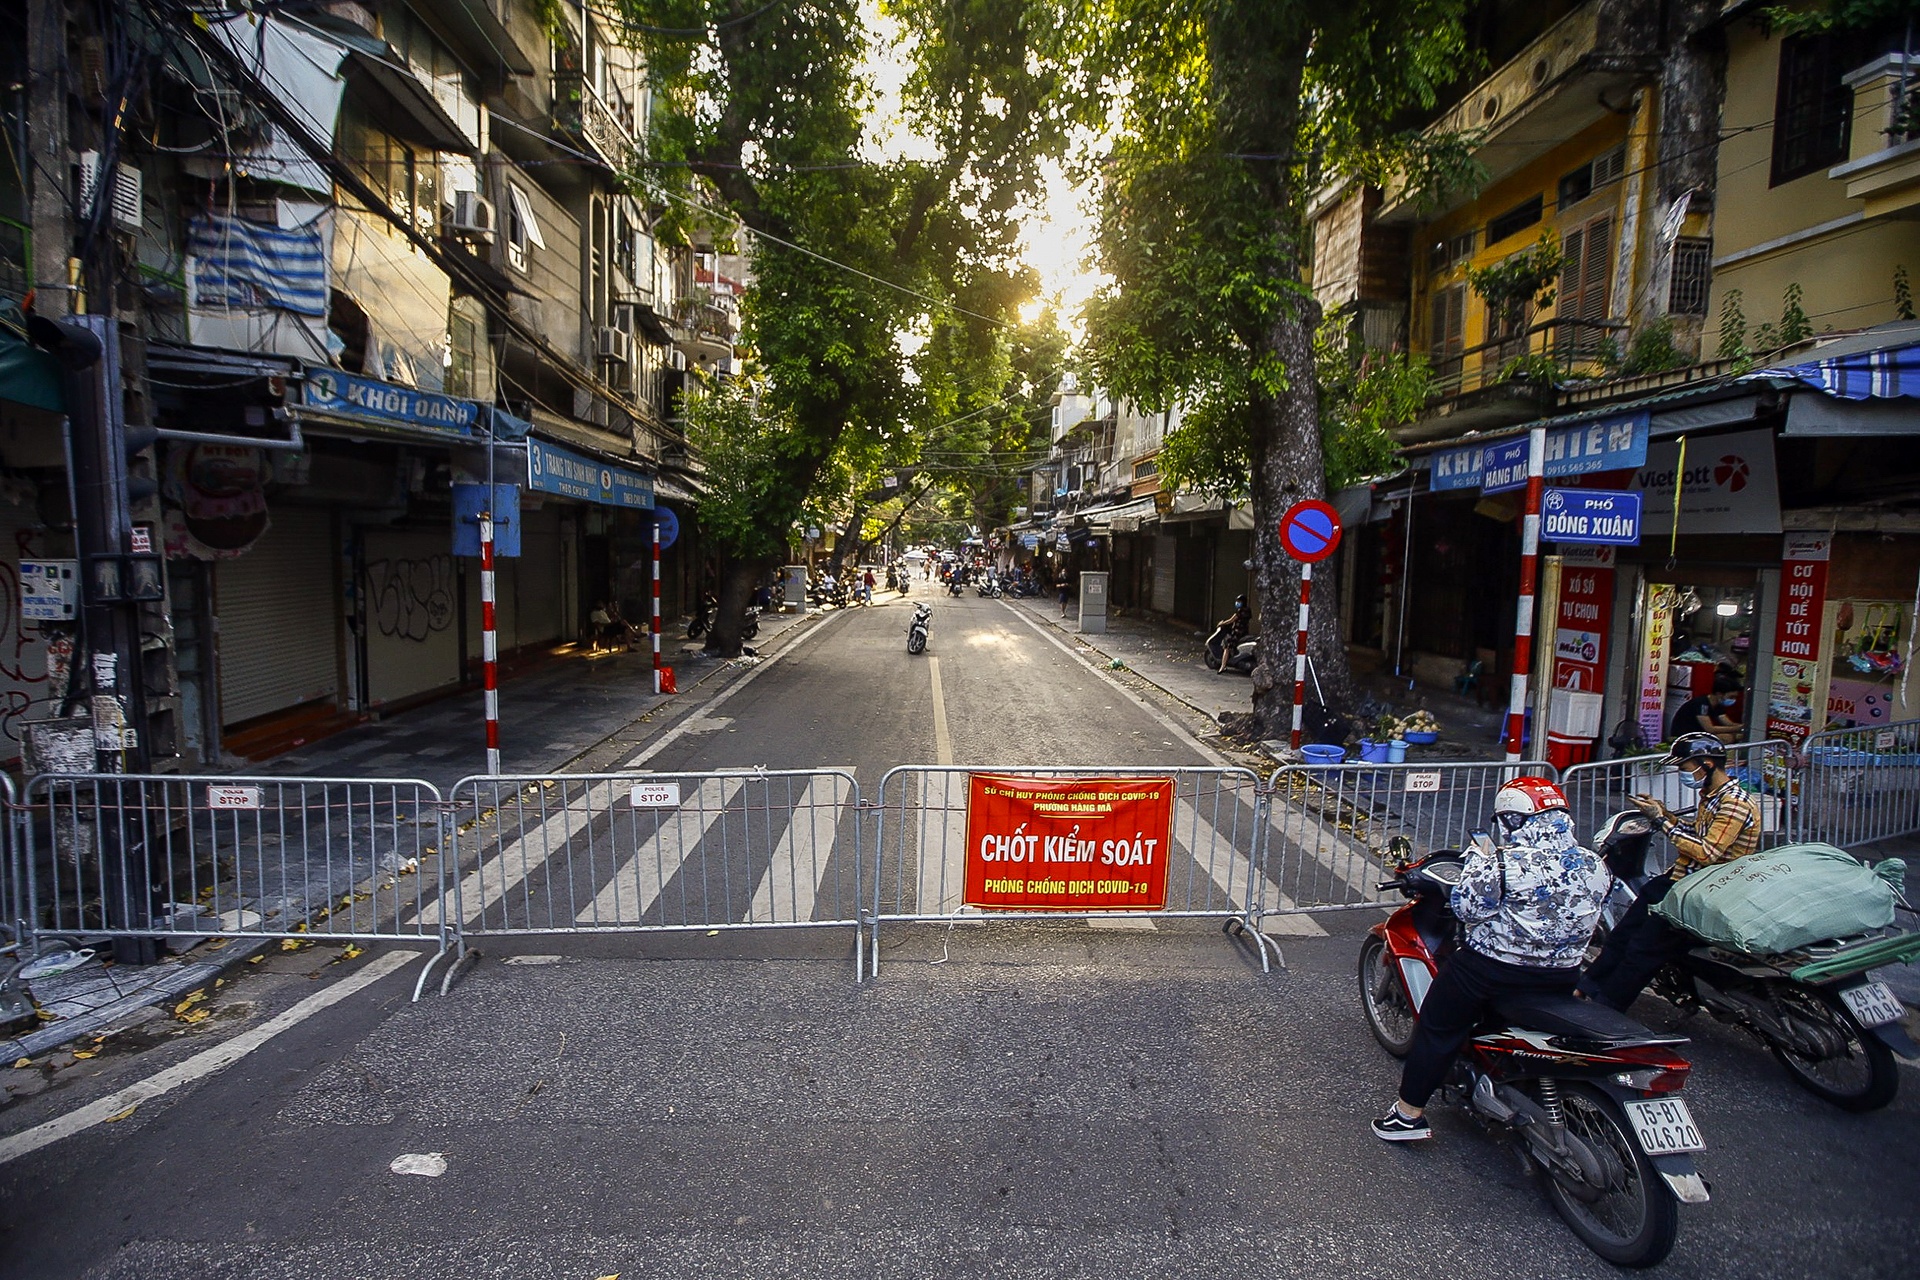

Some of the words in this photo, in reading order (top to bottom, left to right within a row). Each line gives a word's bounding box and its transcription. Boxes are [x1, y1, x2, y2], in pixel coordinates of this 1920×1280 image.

[348, 383, 407, 414] KHÔI
[414, 400, 468, 424] OANH
[533, 444, 542, 476] 3
[1504, 444, 1522, 461] PHỐ
[1485, 466, 1511, 489] HÀNG
[1639, 466, 1710, 488] Vietott
[1584, 497, 1614, 510] PHỐ
[1546, 509, 1588, 534] ĐỒNG
[1591, 515, 1634, 537] XUÂN
[1793, 564, 1814, 578] CƠ
[1583, 573, 1596, 595] SỐ
[1789, 582, 1813, 599] HỘI
[1563, 600, 1575, 620] TỰ
[1575, 602, 1599, 623] CHỌN
[1790, 599, 1810, 616] ĐỂ
[1786, 619, 1811, 636] TỐT
[1559, 641, 1582, 655] Max
[1781, 640, 1810, 655] HƠN
[1641, 700, 1661, 711] TOÁN
[219, 796, 249, 804] STOP
[641, 794, 669, 802] STOP
[999, 788, 1014, 798] CHỈ
[1016, 792, 1033, 800] HUY
[1035, 791, 1065, 801] PHÒNG
[1067, 790, 1096, 801] CHỐNG
[1098, 792, 1119, 802] DỊCH
[1121, 791, 1160, 800] COVID-19
[1033, 801, 1069, 812] PHƯỜNG
[1071, 802, 1095, 812] HÀNG
[1097, 802, 1112, 812] MÃ
[981, 823, 1039, 862] CHỐT
[1044, 824, 1096, 862] KIỂM
[1101, 832, 1158, 867] SOÁT
[984, 876, 1024, 894] PHÒNG
[1027, 876, 1066, 894] CHỐNG
[1068, 879, 1094, 897] DỊCH
[1097, 880, 1148, 894] COVID-19
[1848, 984, 1887, 1008] 29-V5
[1857, 1000, 1903, 1024] 270.94
[1635, 1101, 1683, 1126] 15-B1
[1640, 1125, 1700, 1150] 046.20
